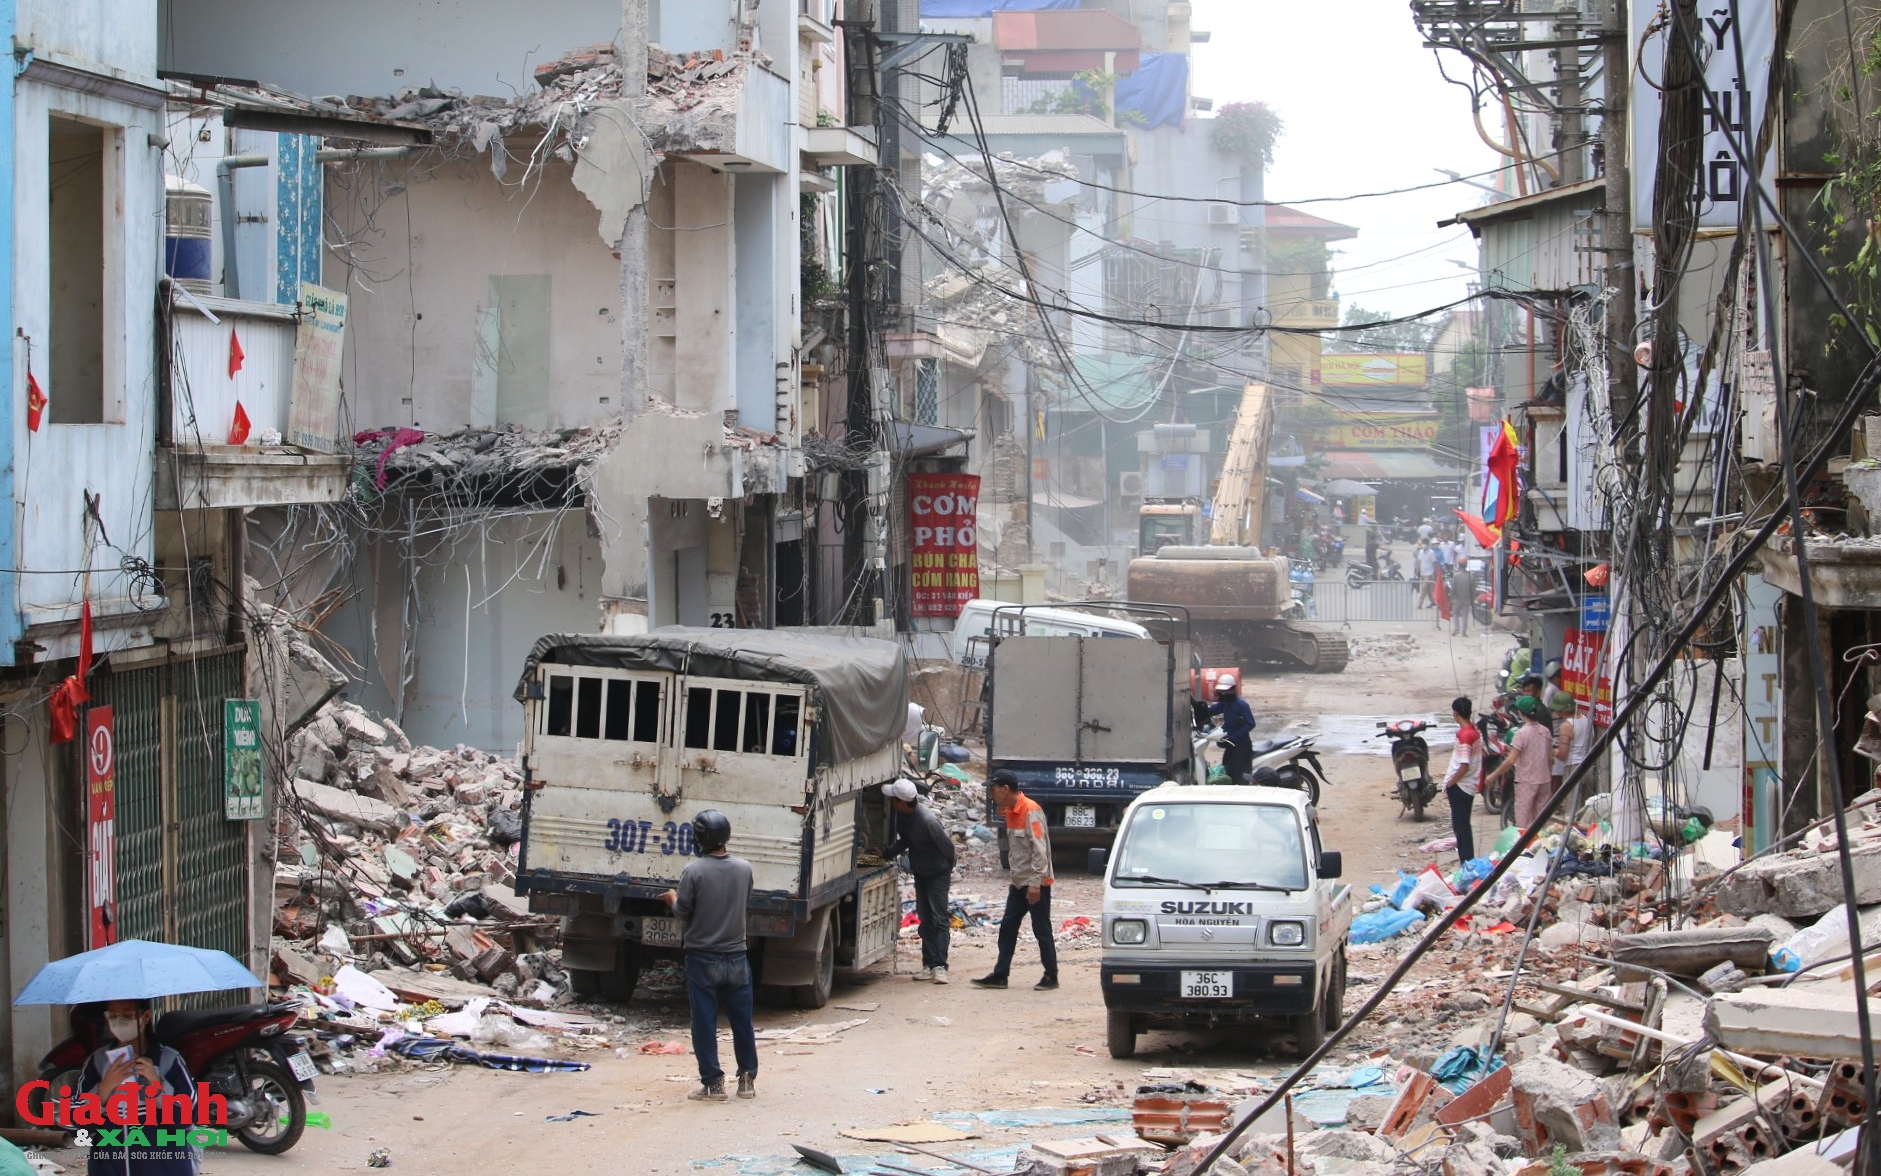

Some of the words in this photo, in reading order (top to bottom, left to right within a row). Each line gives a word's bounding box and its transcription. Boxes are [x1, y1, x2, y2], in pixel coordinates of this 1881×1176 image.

[912, 491, 977, 516] CƠM
[913, 519, 976, 546] PHỞ
[913, 551, 945, 568] BÚN
[949, 550, 977, 568] CHẢ
[912, 571, 942, 587] CƠM
[946, 573, 977, 588] RANG
[931, 592, 941, 600] 31
[957, 590, 974, 600] KIẾP
[711, 613, 735, 628] 23
[1563, 634, 1593, 675] CẮT
[1072, 807, 1088, 817] 88C
[605, 818, 704, 858] 30T-30
[1161, 901, 1253, 915] SUZUKI
[650, 918, 673, 931] 30T
[1196, 973, 1218, 984] 36C
[1187, 985, 1228, 997] 380.93
